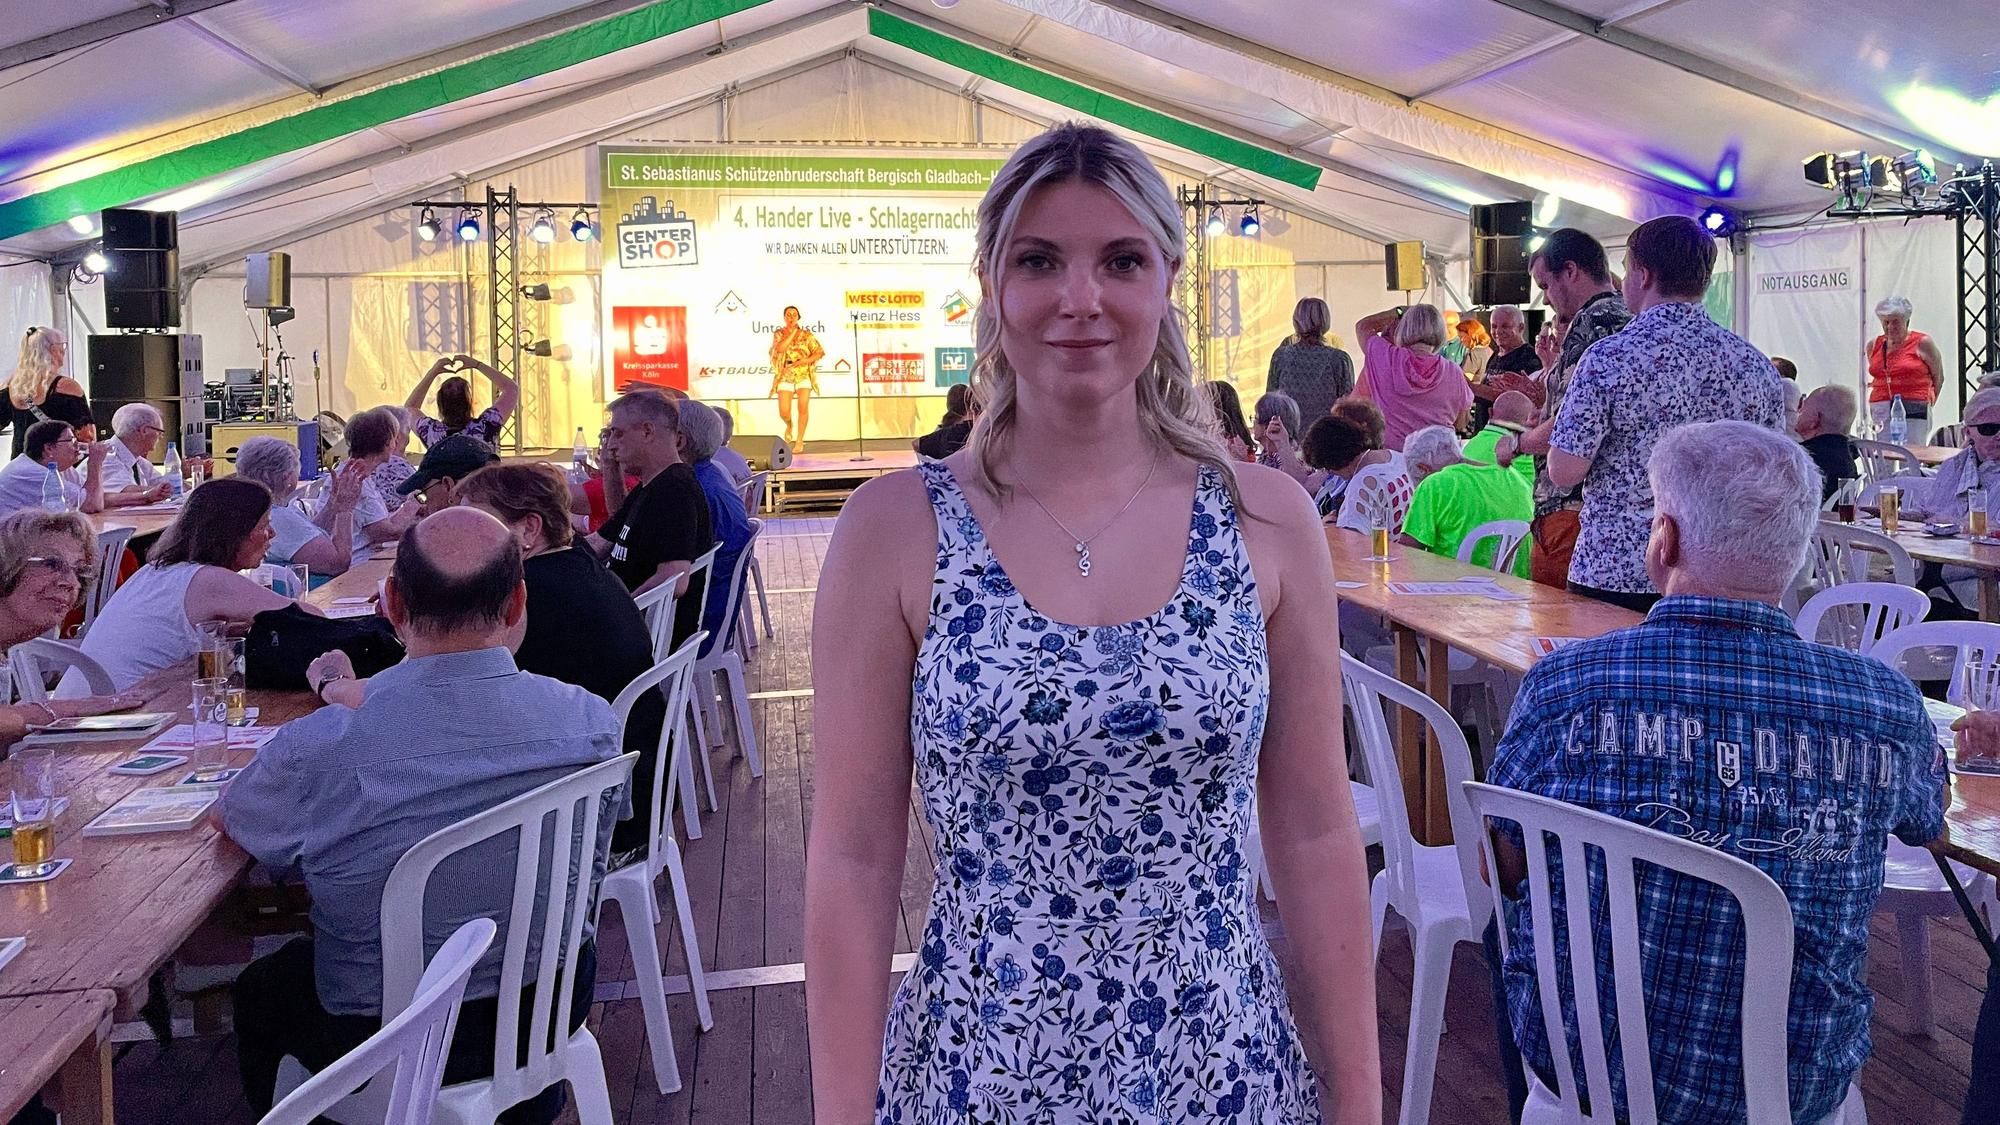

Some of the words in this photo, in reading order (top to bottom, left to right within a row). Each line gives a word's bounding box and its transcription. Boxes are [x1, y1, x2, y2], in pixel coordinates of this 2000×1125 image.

[621, 164, 639, 180] St.
[642, 165, 722, 181] Sebastianus
[725, 166, 865, 183] Schützenbruderschaft
[867, 167, 922, 186] Bergisch
[734, 205, 748, 228] 4.
[756, 205, 813, 228] Hander
[820, 206, 852, 228] Live
[869, 206, 978, 234] Schlagernacht
[622, 228, 692, 244] CENTER
[765, 242, 781, 254] WIR
[784, 242, 818, 255] DANKEN
[821, 242, 847, 255] ALLEN
[850, 234, 949, 255] UNTERSTÜTZERN:
[625, 240, 690, 260] SHOP
[1762, 272, 1848, 291] NOTAUSGANG
[849, 294, 878, 304] WEST
[888, 294, 922, 304] LOTTO
[850, 310, 886, 321] Heinz
[889, 310, 921, 321] Hess
[1567, 710, 1704, 762] CAMP
[1754, 728, 1893, 788] DAVID
